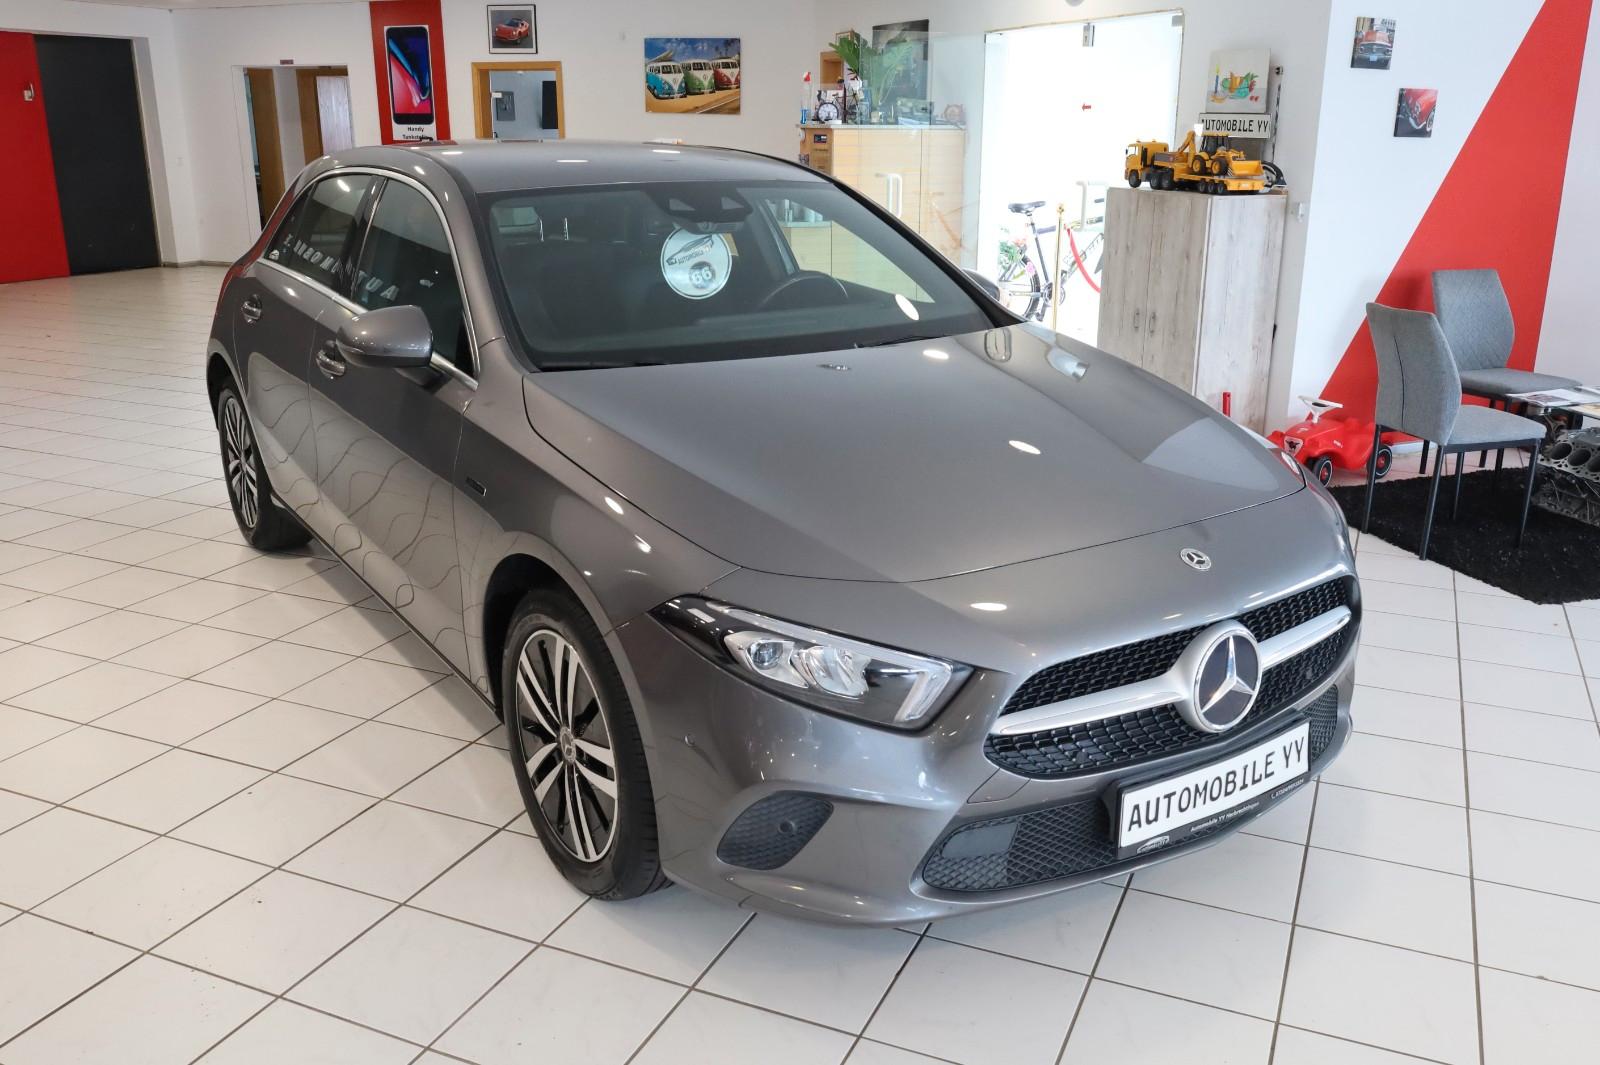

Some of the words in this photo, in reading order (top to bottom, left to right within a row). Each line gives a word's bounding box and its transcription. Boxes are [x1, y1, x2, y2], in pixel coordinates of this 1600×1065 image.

[1257, 120, 1269, 132] YY
[1128, 751, 1275, 832] AUTOMOBILE
[1283, 736, 1304, 768] YY
